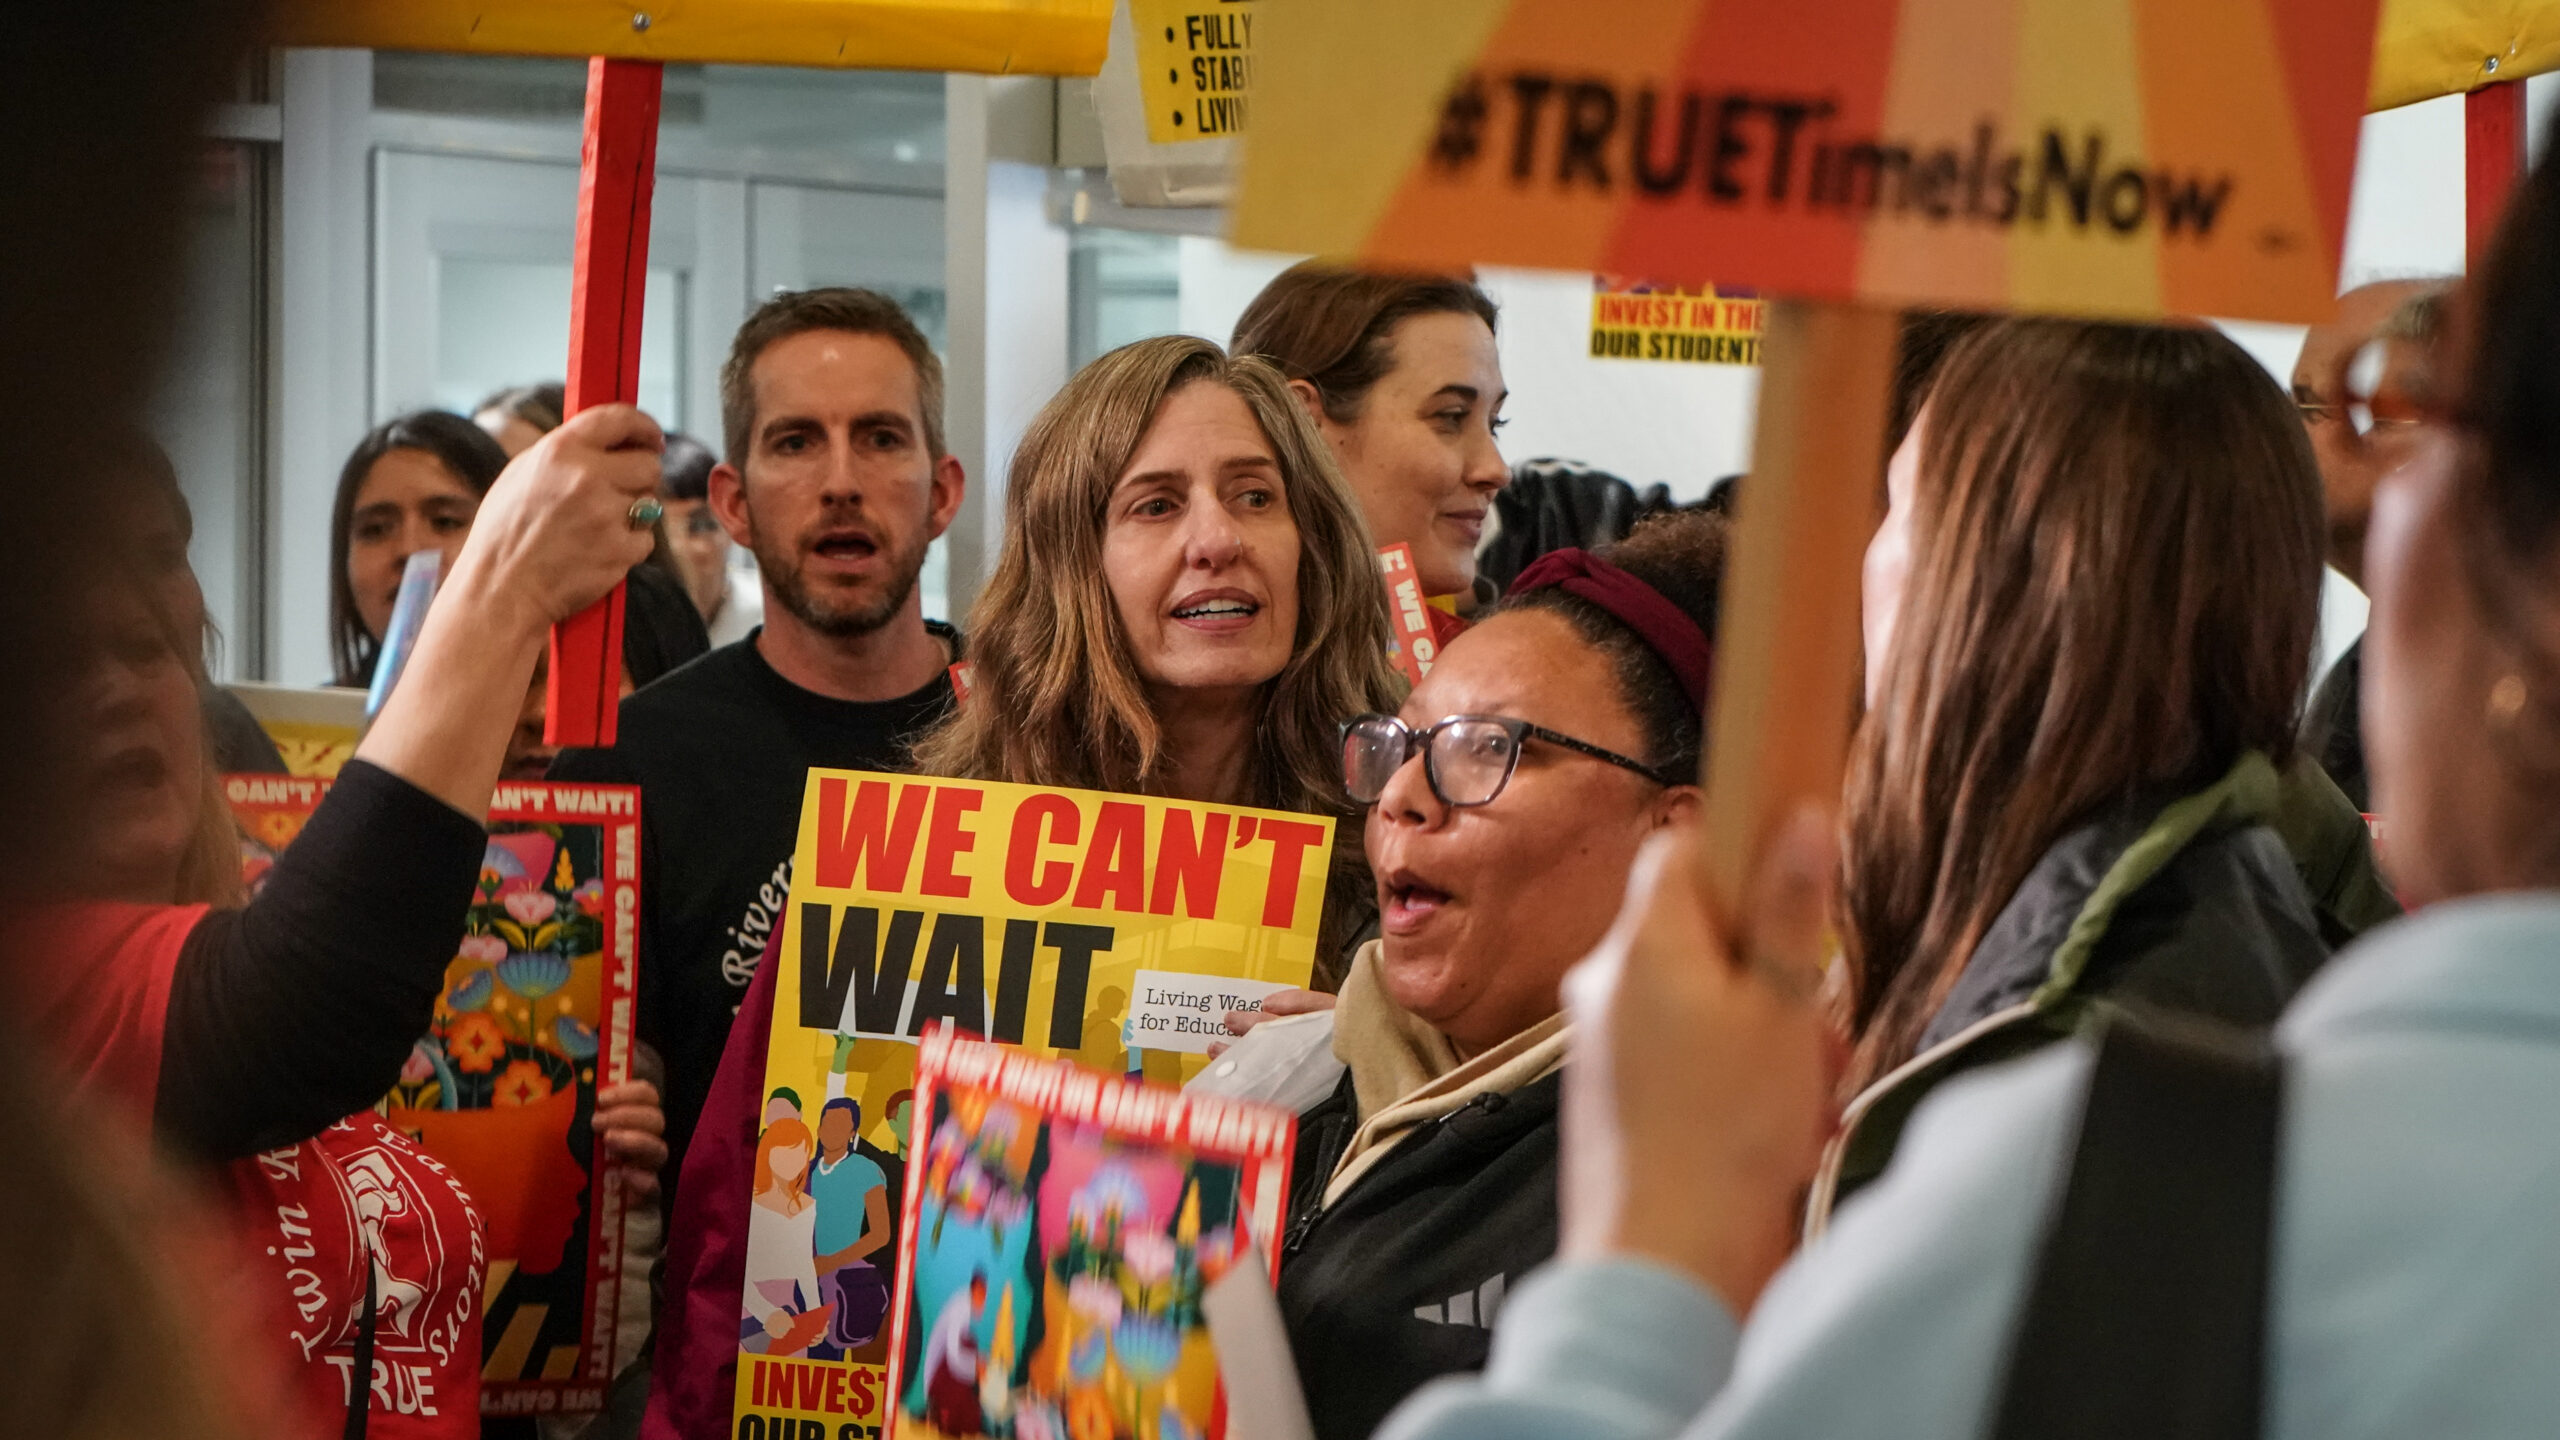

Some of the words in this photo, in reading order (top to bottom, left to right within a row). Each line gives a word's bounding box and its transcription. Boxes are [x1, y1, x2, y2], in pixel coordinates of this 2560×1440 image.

[1185, 13, 1252, 51] FULLY
[1430, 76, 2234, 236] #TRUETimeIsNow
[1690, 302, 1715, 329] IN
[1592, 329, 1641, 357] OUR
[1649, 332, 1759, 363] STUDENT
[1395, 578, 1427, 633] WE
[227, 778, 316, 804] CAN'T
[490, 785, 549, 811] AN'T
[553, 791, 635, 816] WAIT!
[615, 823, 636, 881] WE
[815, 777, 984, 898] WE
[1004, 793, 1325, 929] CAN'T
[613, 885, 635, 992] CAN'T
[722, 856, 794, 986] River
[799, 902, 1115, 1050] WAIT
[1145, 987, 1213, 1013] Living
[1218, 994, 1264, 1013] Wag
[608, 998, 631, 1087] WAIT
[1139, 1013, 1170, 1031] for
[373, 1123, 484, 1367] Educators
[266, 1202, 332, 1362] Twin
[324, 1355, 438, 1416] TRUE
